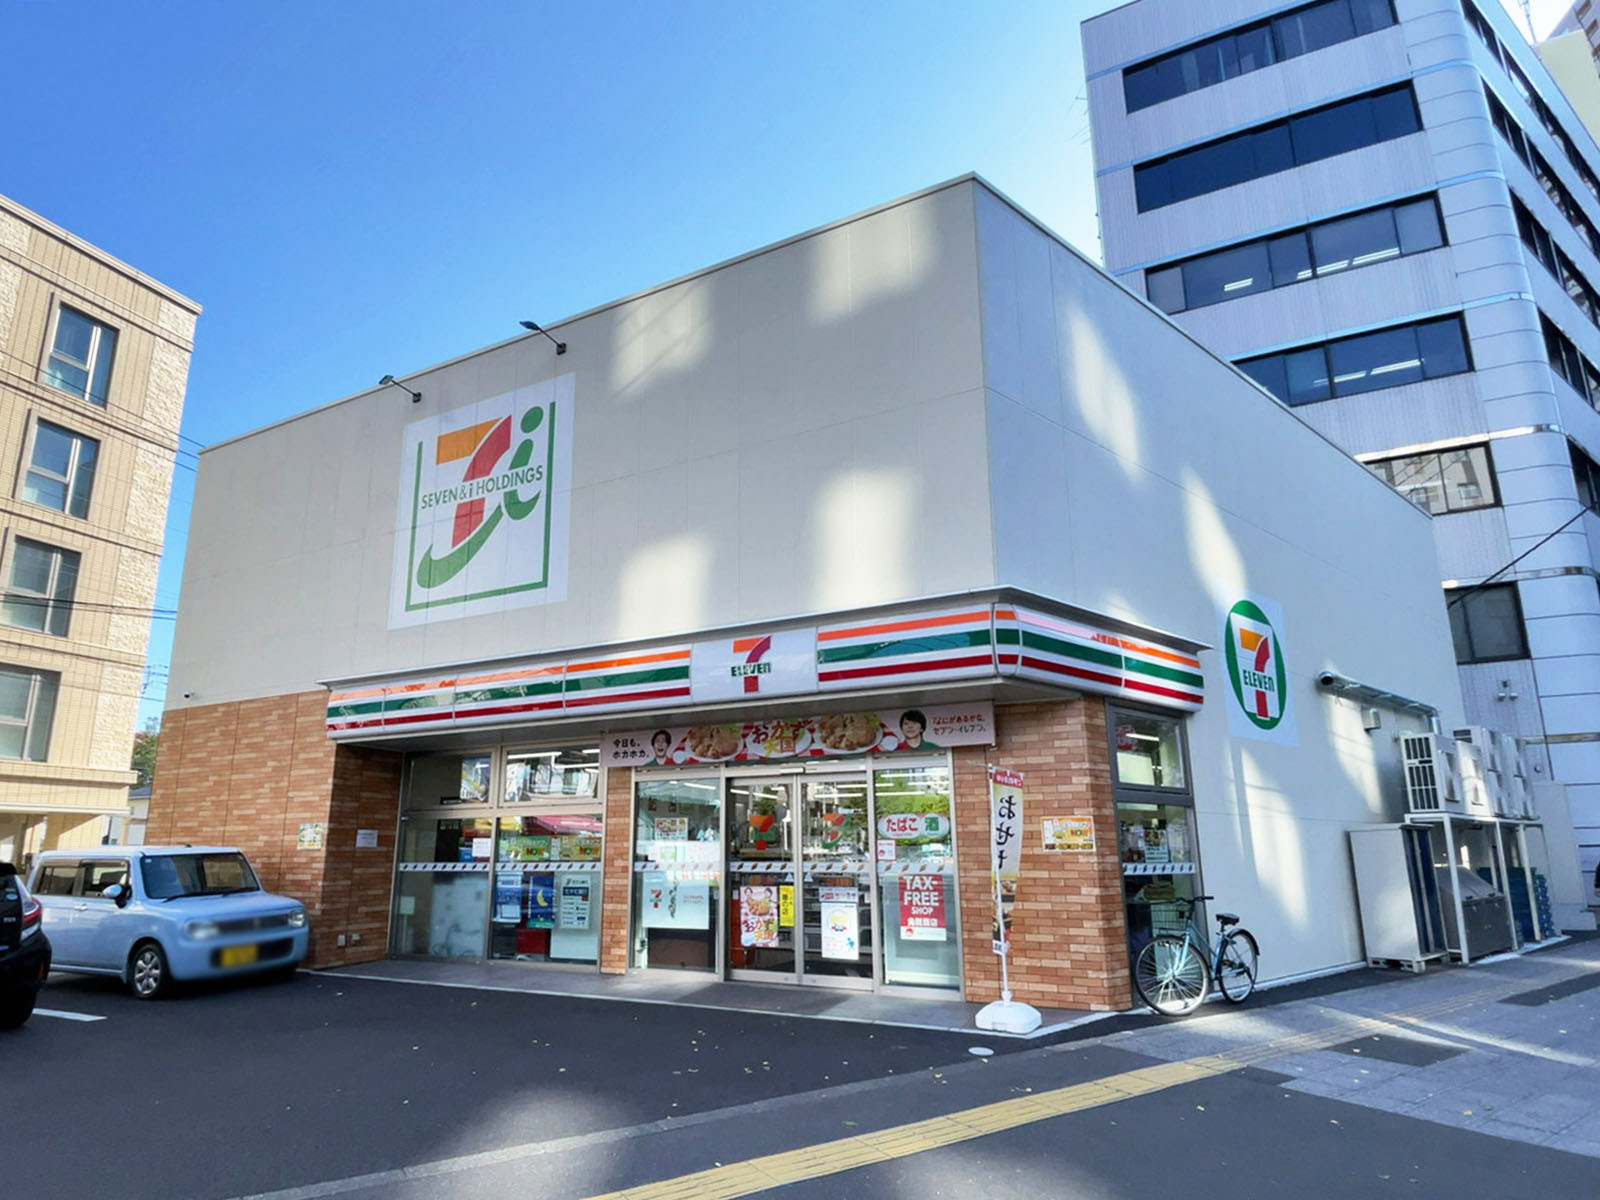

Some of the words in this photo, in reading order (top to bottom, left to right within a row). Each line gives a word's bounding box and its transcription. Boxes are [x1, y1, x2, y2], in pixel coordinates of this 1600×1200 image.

[476, 465, 543, 496] HOLDINGS
[752, 719, 813, 744] おかず
[886, 817, 919, 832] たばこ
[925, 816, 940, 831] 酒
[903, 875, 938, 890] TAX-
[904, 891, 939, 906] FREE
[911, 907, 933, 915] SHOP
